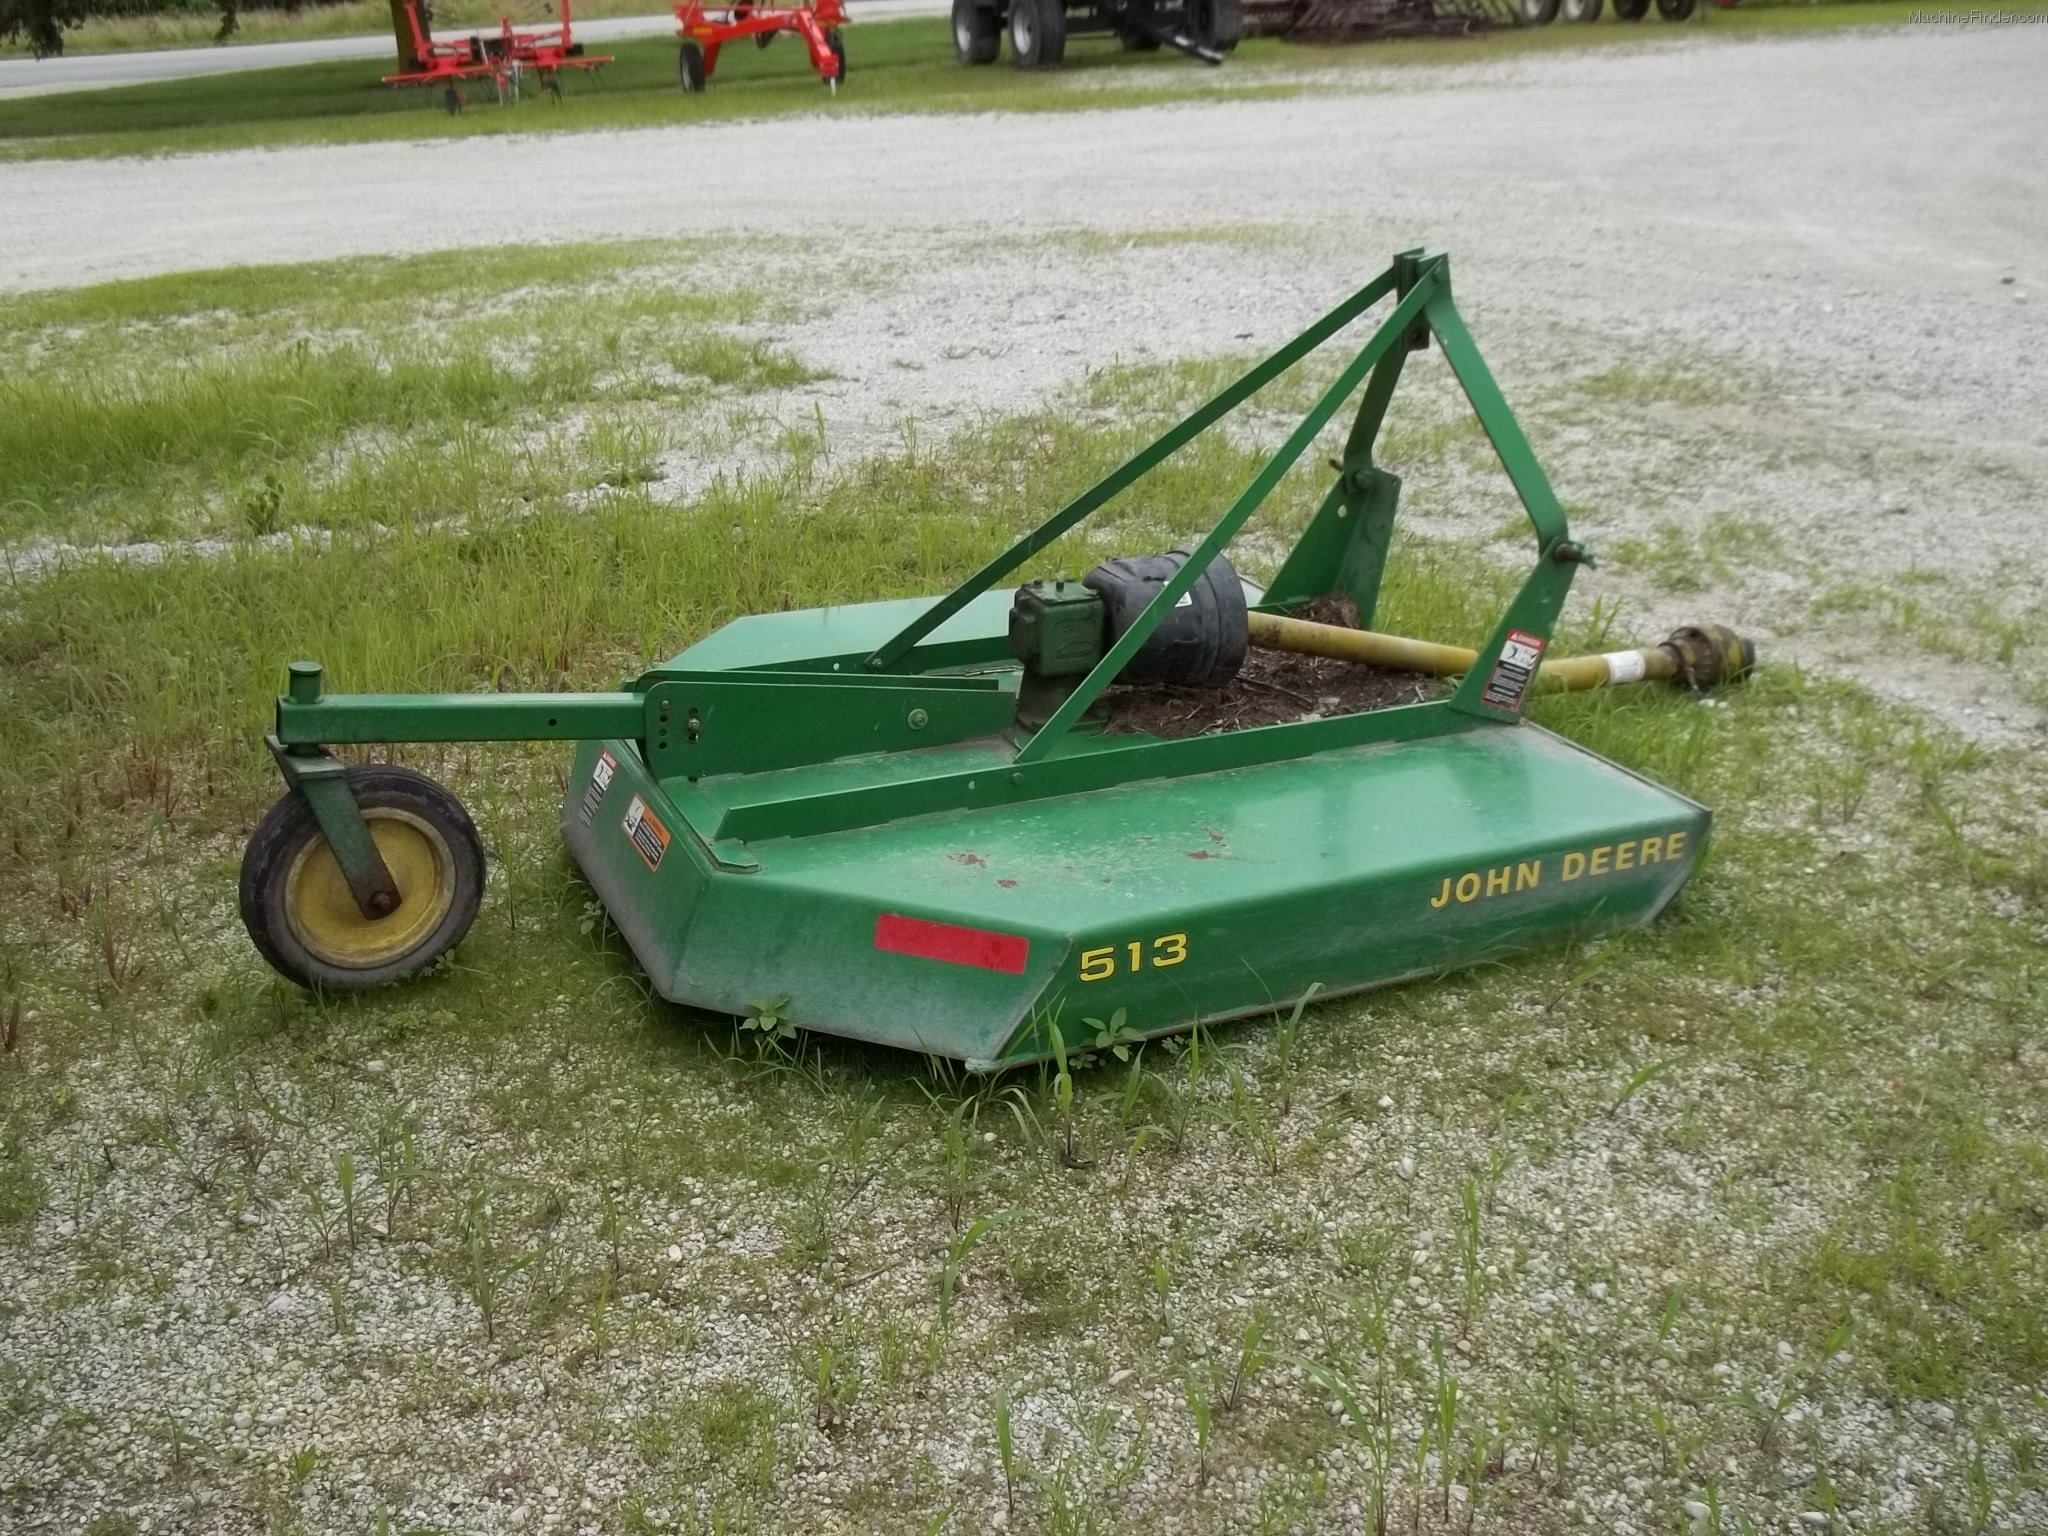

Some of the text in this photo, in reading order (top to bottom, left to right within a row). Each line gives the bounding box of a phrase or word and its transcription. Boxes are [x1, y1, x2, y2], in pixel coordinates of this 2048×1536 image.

[1430, 831, 1687, 908] JOHN DEERE
[1079, 933, 1188, 982] 513
